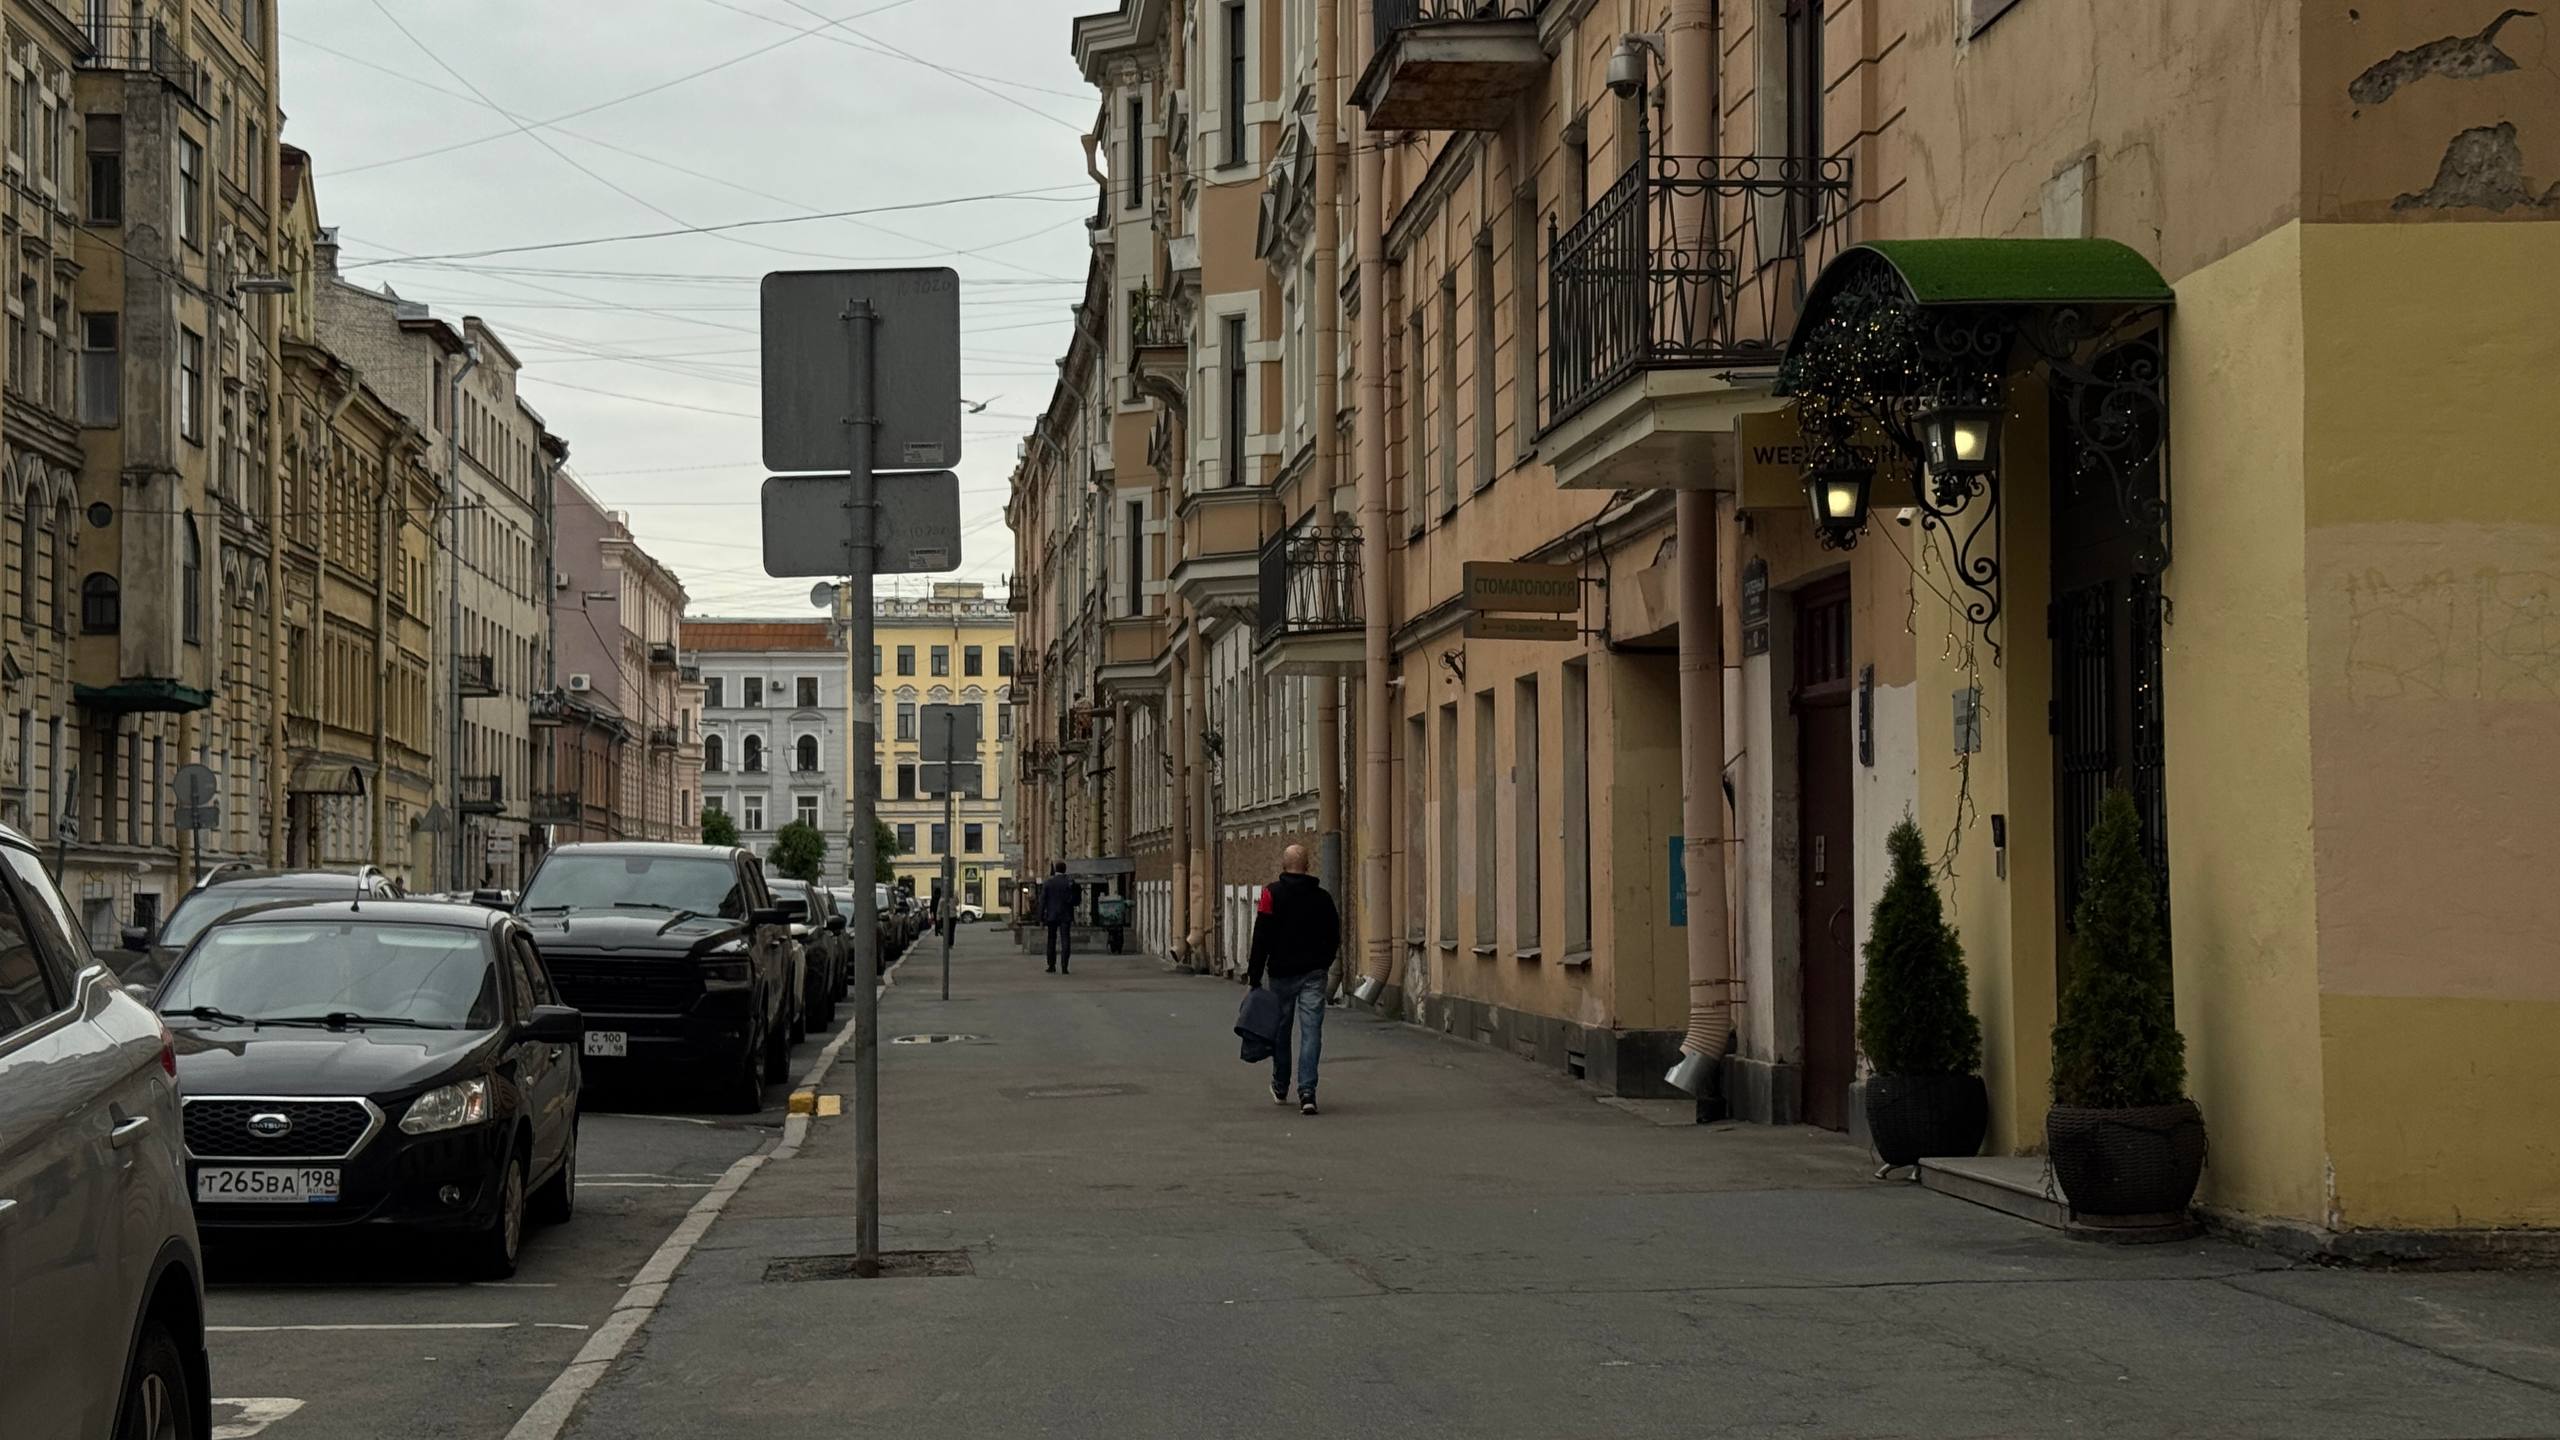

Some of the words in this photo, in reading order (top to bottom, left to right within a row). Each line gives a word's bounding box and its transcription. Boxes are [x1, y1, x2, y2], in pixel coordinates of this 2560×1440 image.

[1474, 577, 1576, 597] СТОМАТОЛОГИЯ
[603, 1033, 621, 1043] 100
[205, 1170, 295, 1193] Т265ВА
[301, 1170, 336, 1187] 198
